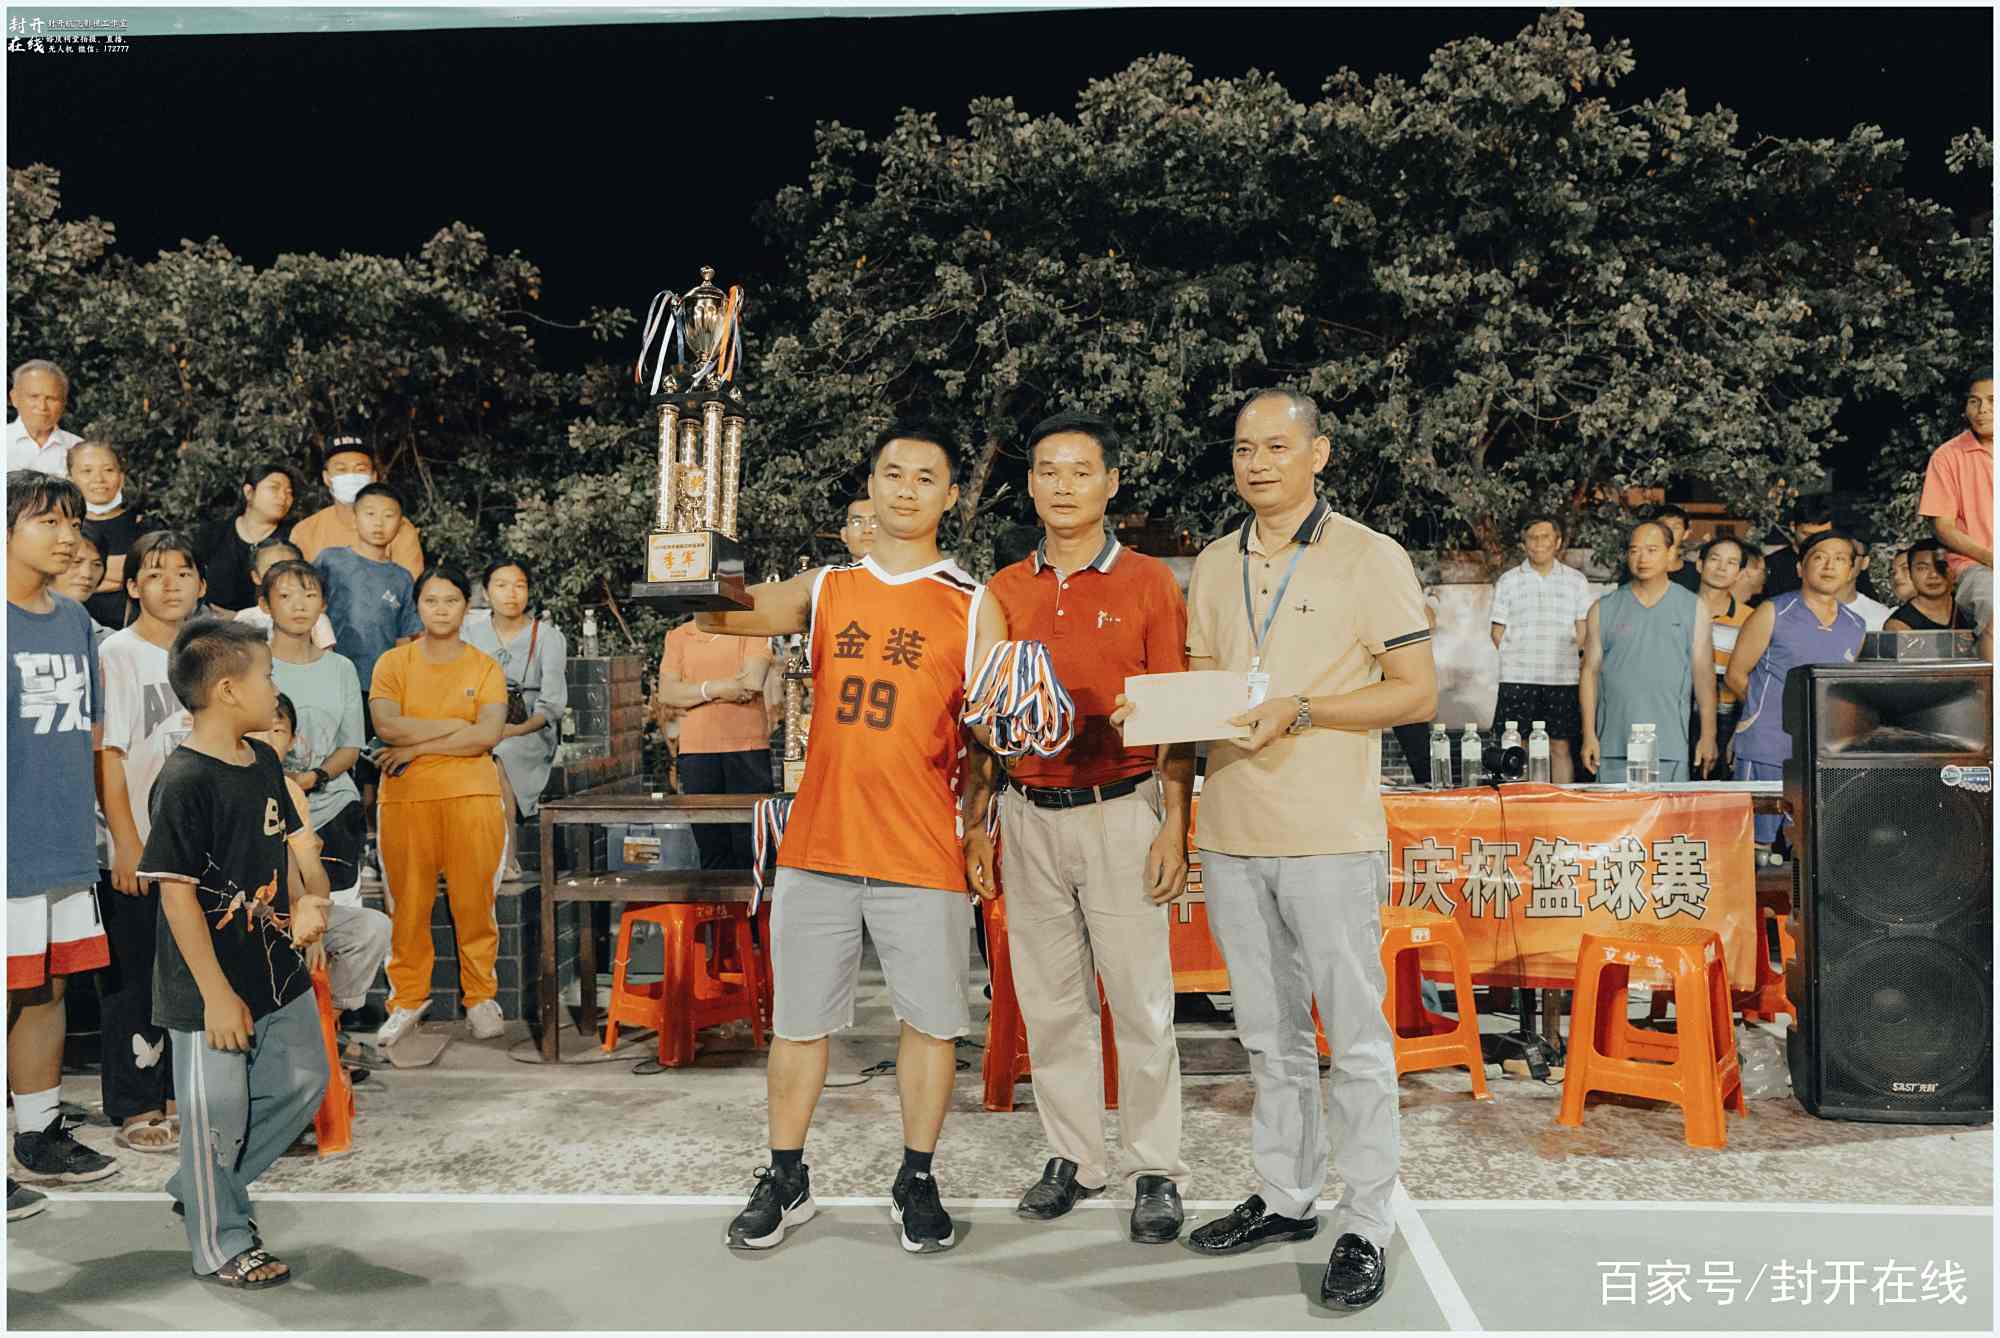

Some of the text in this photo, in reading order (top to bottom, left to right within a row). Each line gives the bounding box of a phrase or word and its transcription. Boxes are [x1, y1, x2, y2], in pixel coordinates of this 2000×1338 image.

[833, 620, 926, 670] 金装
[836, 675, 897, 731] 99
[1388, 834, 1711, 920] 庆杯篮球赛
